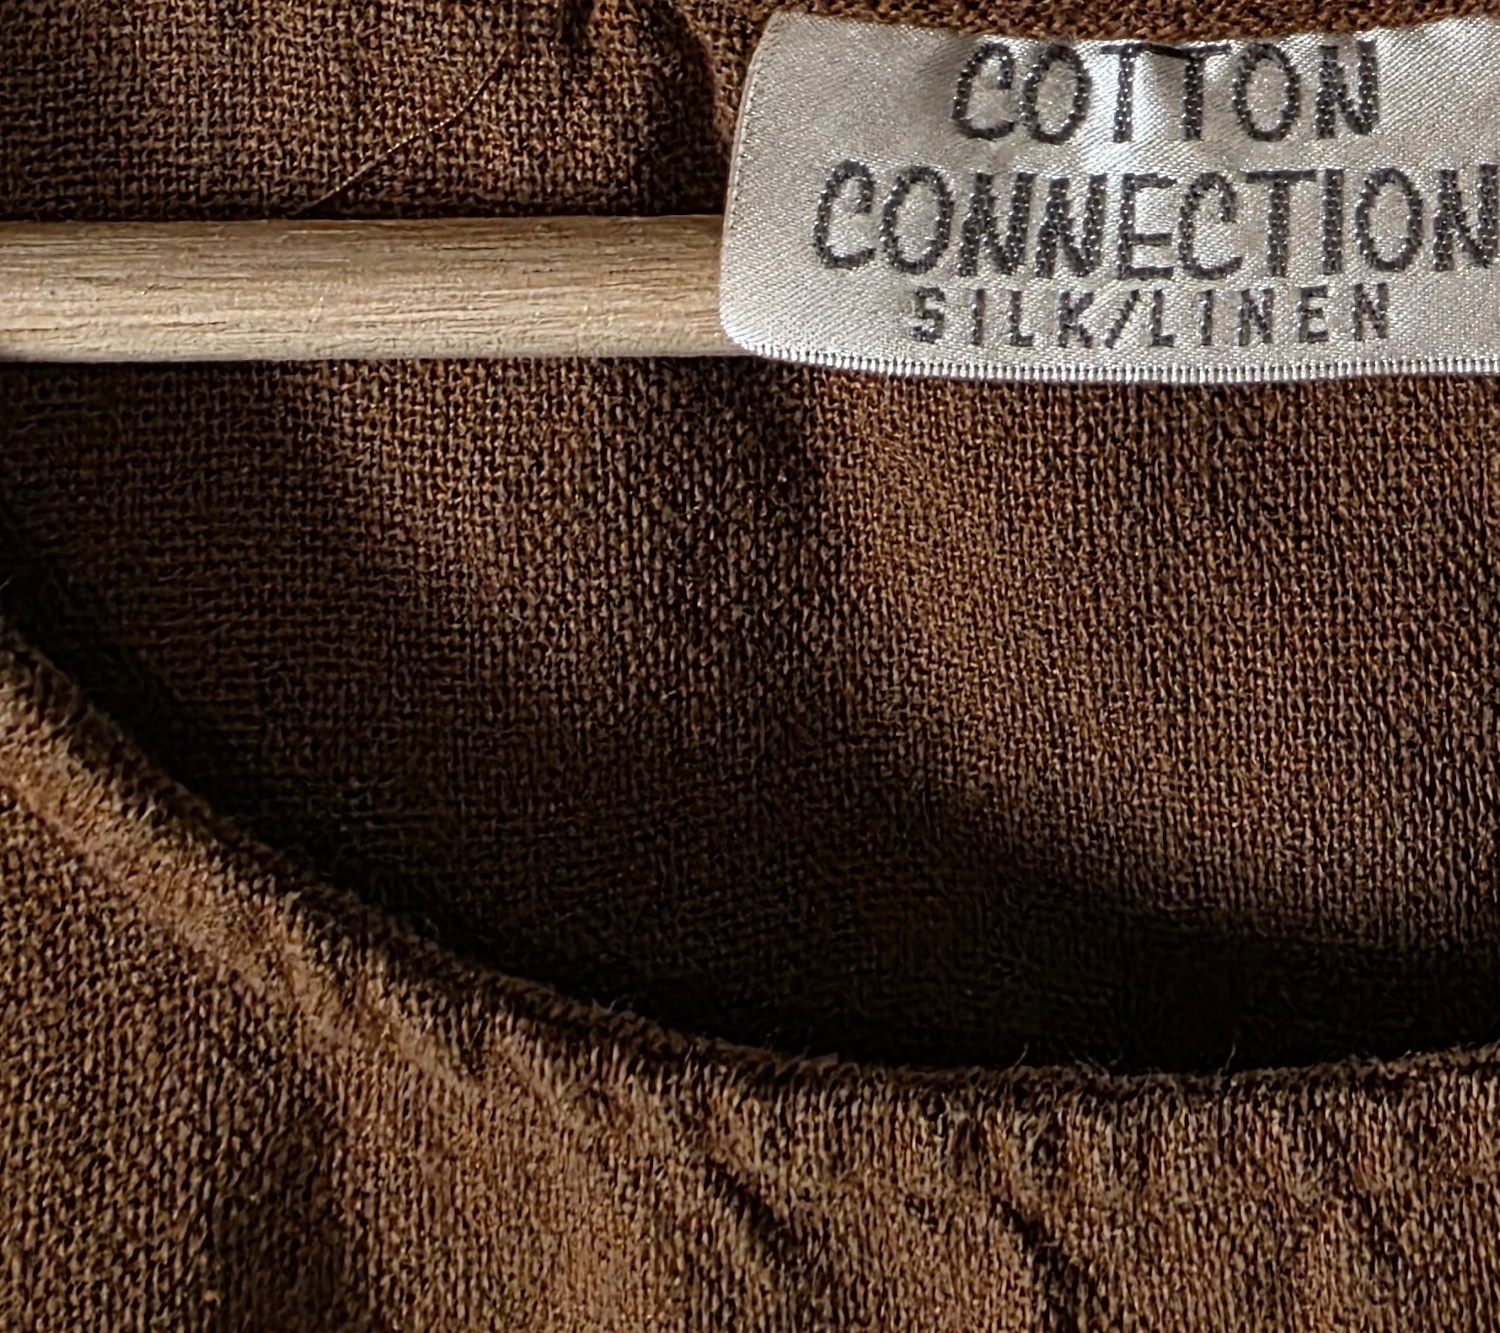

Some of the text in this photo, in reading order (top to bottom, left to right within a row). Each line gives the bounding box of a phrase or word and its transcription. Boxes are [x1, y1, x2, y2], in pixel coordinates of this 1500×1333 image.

[952, 39, 1378, 144] COTTON
[812, 159, 1500, 279] CONNECTION
[911, 282, 1390, 350] SILK/LINEN
